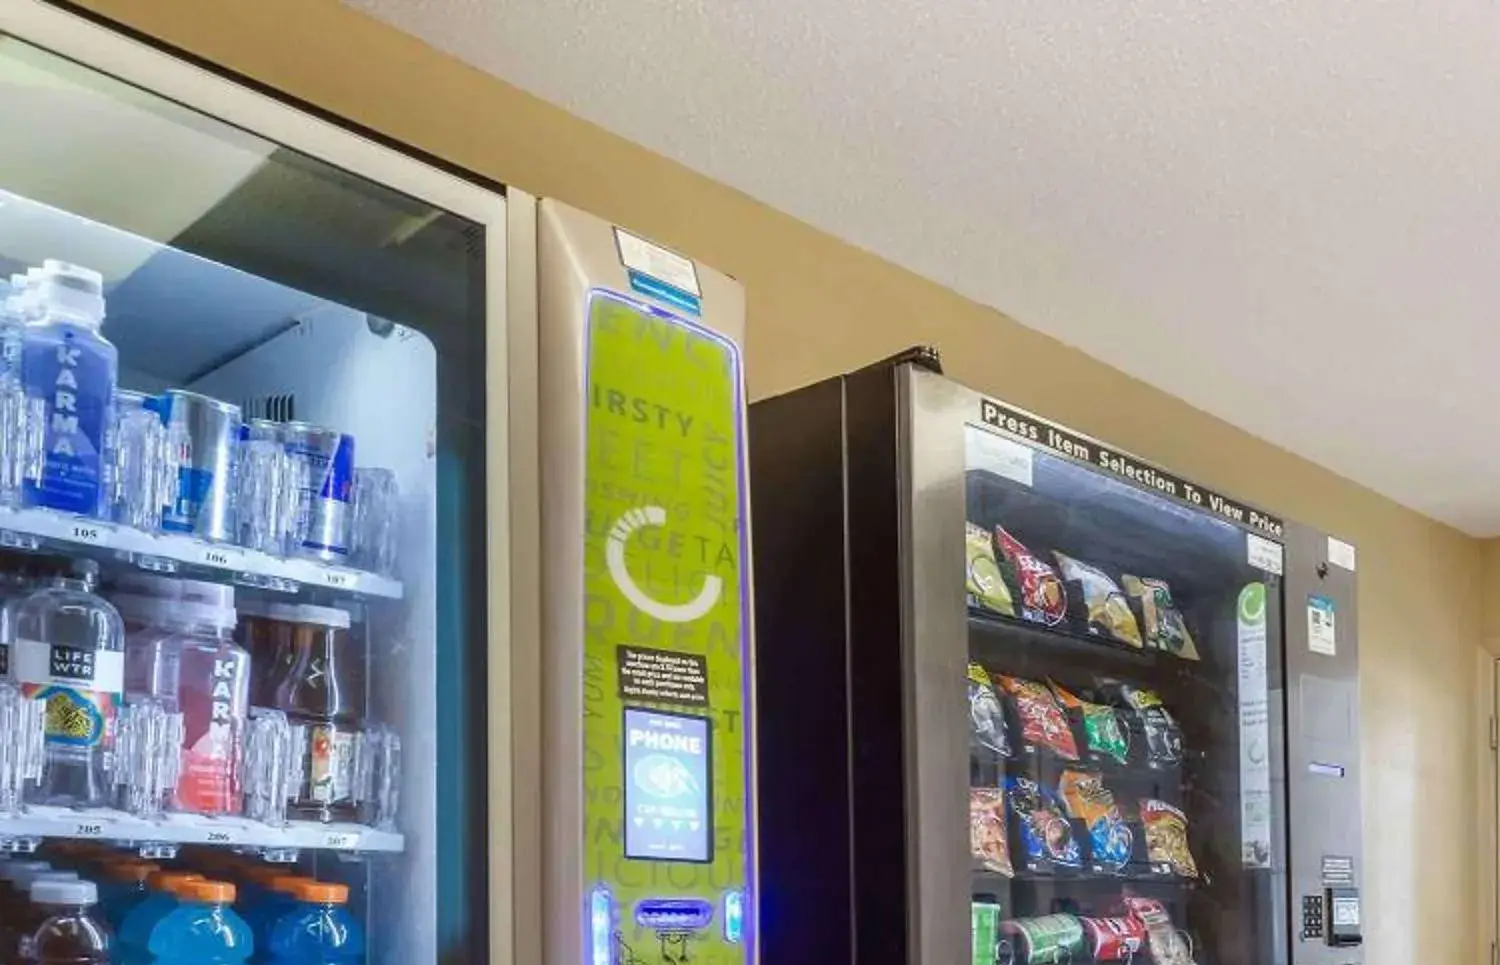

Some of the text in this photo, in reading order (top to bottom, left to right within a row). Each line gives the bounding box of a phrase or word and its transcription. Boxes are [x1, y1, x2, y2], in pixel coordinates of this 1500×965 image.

[52, 345, 80, 456] KARMA
[984, 404, 1283, 537] Press Item Selection To View Price
[54, 663, 92, 676] WTR
[210, 659, 235, 761] KARMA
[629, 728, 702, 755] PHONE
